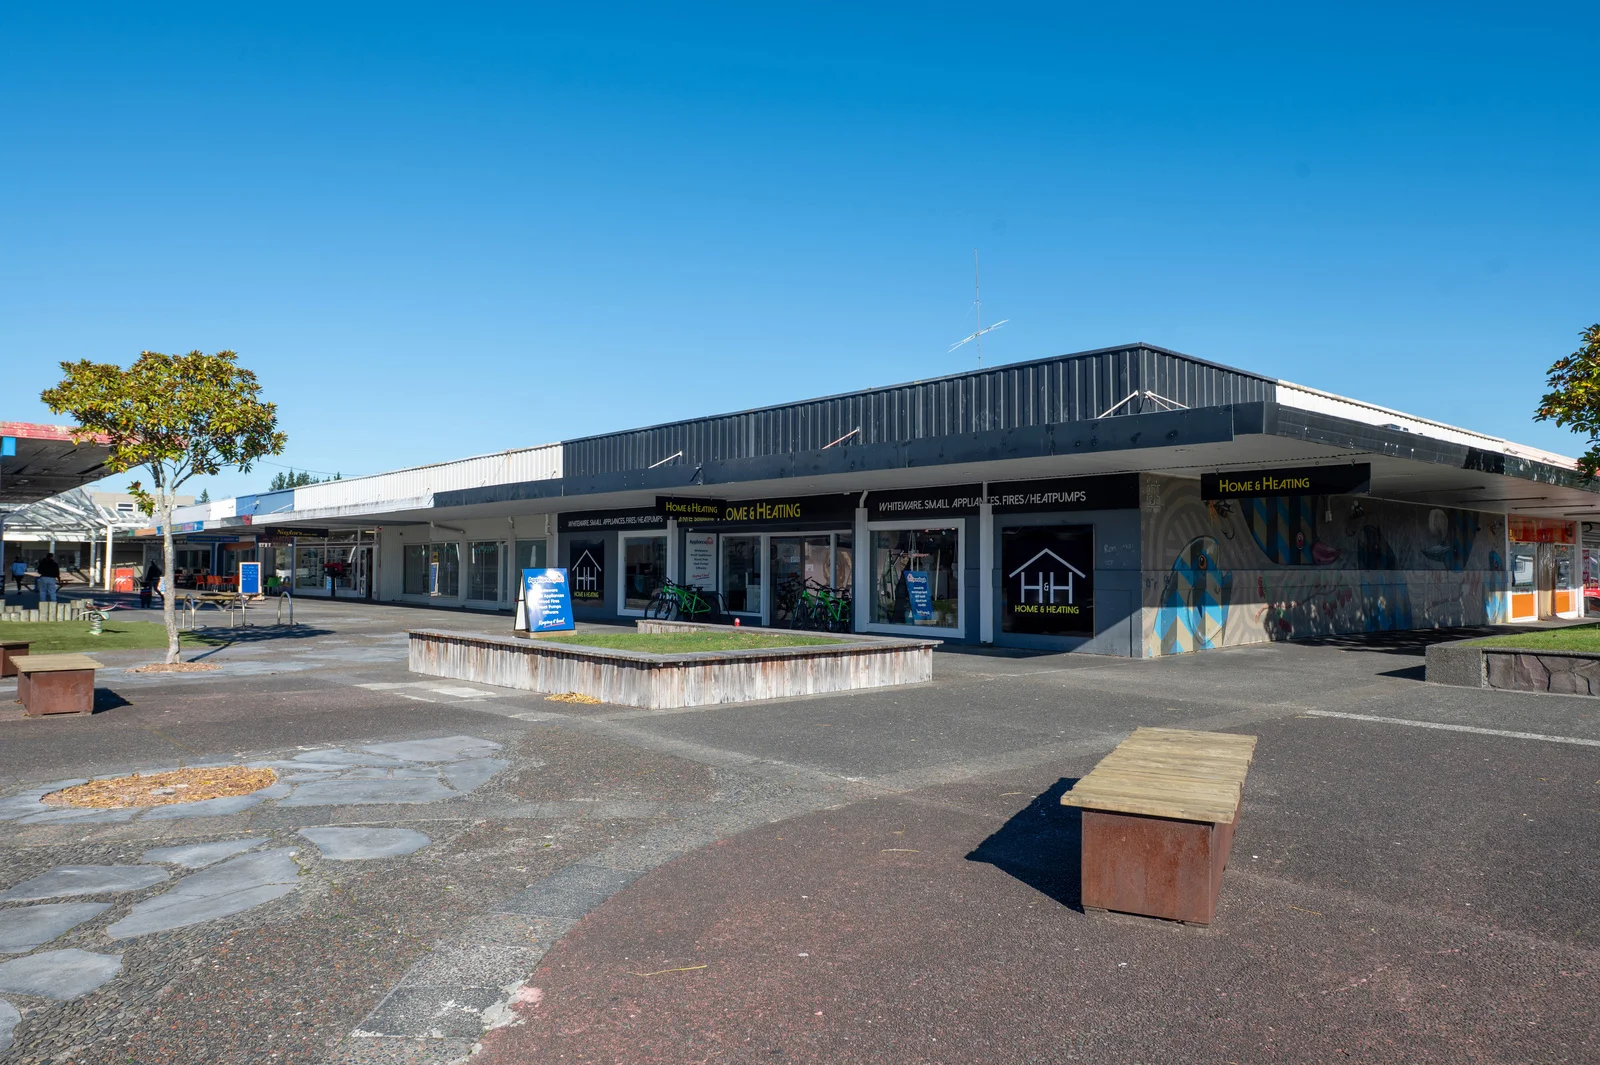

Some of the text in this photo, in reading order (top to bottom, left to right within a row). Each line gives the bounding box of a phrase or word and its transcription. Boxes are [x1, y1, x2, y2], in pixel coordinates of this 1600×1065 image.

[1219, 476, 1310, 493] HOME & HEATING
[665, 501, 687, 513] HOME
[691, 503, 718, 514] HEATING
[725, 502, 801, 521] OME & HEATING
[1014, 605, 1079, 614] HOME & HEATING
